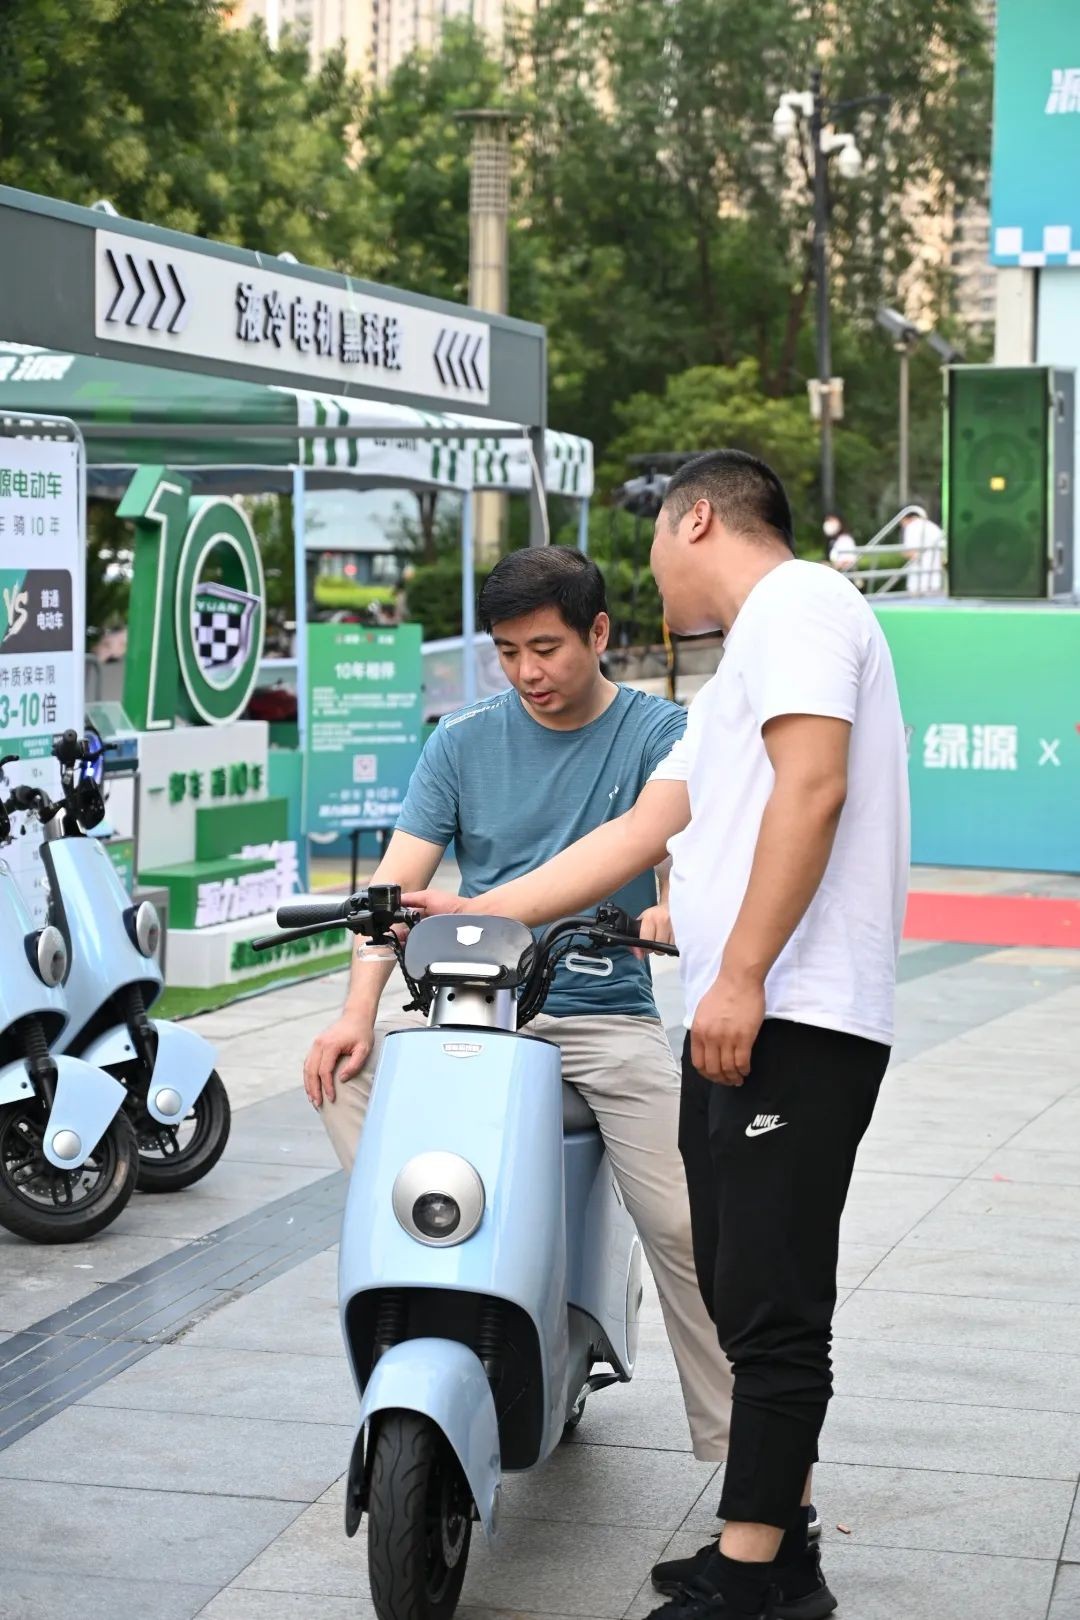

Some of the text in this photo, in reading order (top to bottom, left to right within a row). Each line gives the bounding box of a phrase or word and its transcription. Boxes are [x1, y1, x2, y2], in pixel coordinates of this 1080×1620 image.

[41, 589, 60, 608] 普通
[115, 464, 266, 731] 10
[36, 611, 64, 630] 电动车
[922, 723, 1018, 771] 绿源
[752, 1114, 780, 1128] NIKE
